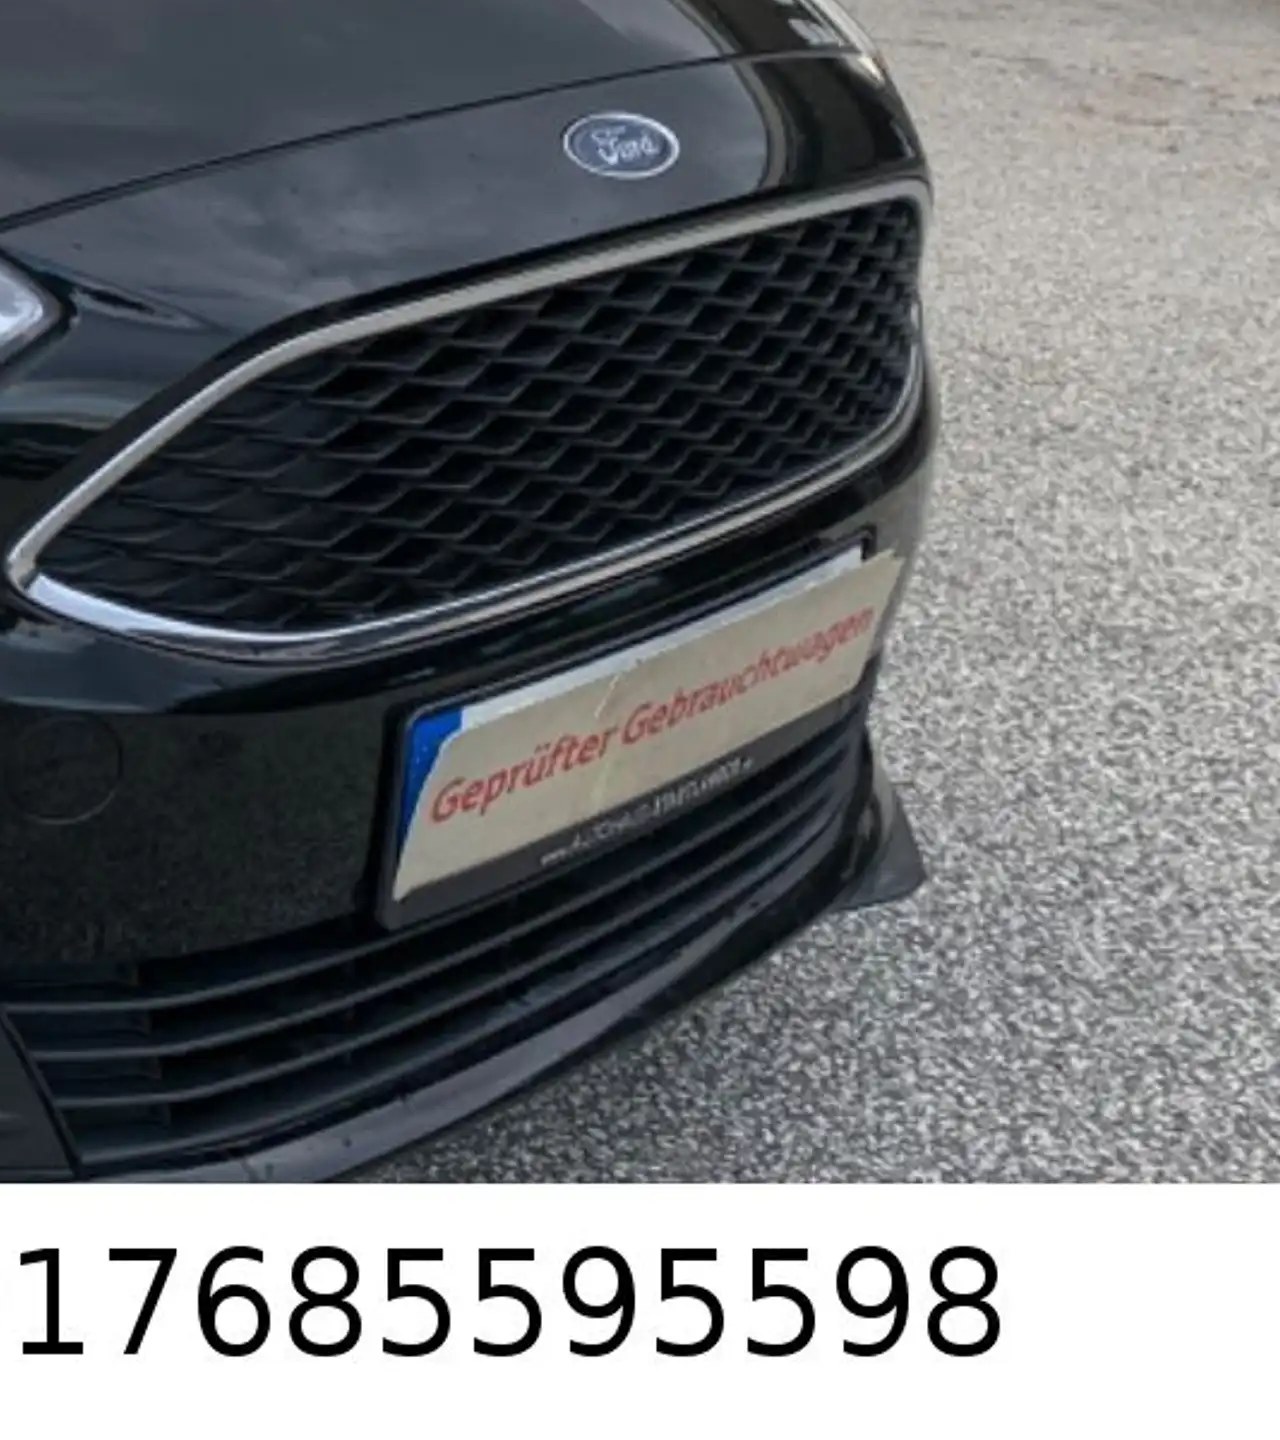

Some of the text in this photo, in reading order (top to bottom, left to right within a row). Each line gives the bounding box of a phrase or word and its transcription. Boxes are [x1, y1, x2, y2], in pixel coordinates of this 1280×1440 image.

[591, 125, 660, 166] Ford
[429, 723, 621, 824] Geprüfter
[620, 606, 876, 747] Gebrauchtwagen
